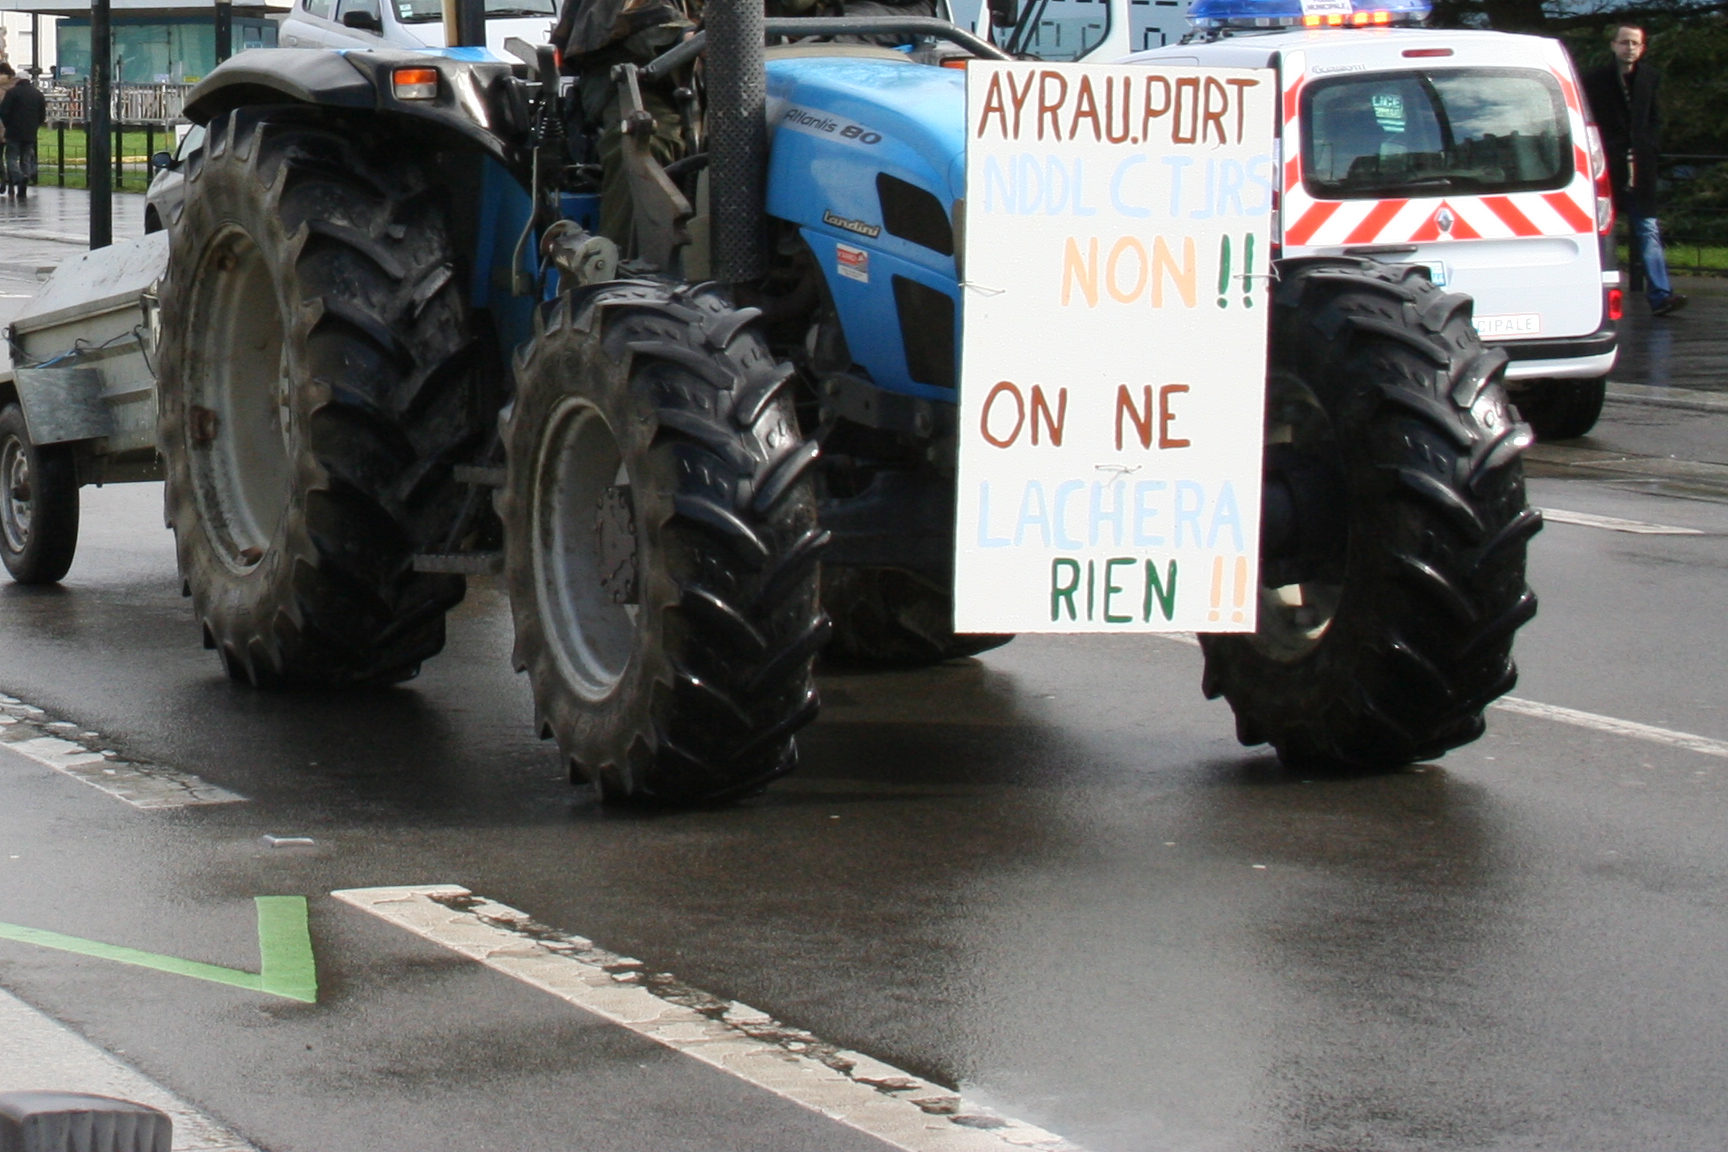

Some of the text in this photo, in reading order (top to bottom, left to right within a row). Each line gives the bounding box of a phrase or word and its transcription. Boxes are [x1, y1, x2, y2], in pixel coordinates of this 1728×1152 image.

[783, 109, 882, 145] Atlantis 80
[983, 153, 1098, 217] NDDL
[1060, 232, 1255, 309] NON !!
[979, 381, 1191, 450] ON NE
[977, 479, 1244, 552] LACHERA
[1050, 554, 1248, 624] RIEN !!
